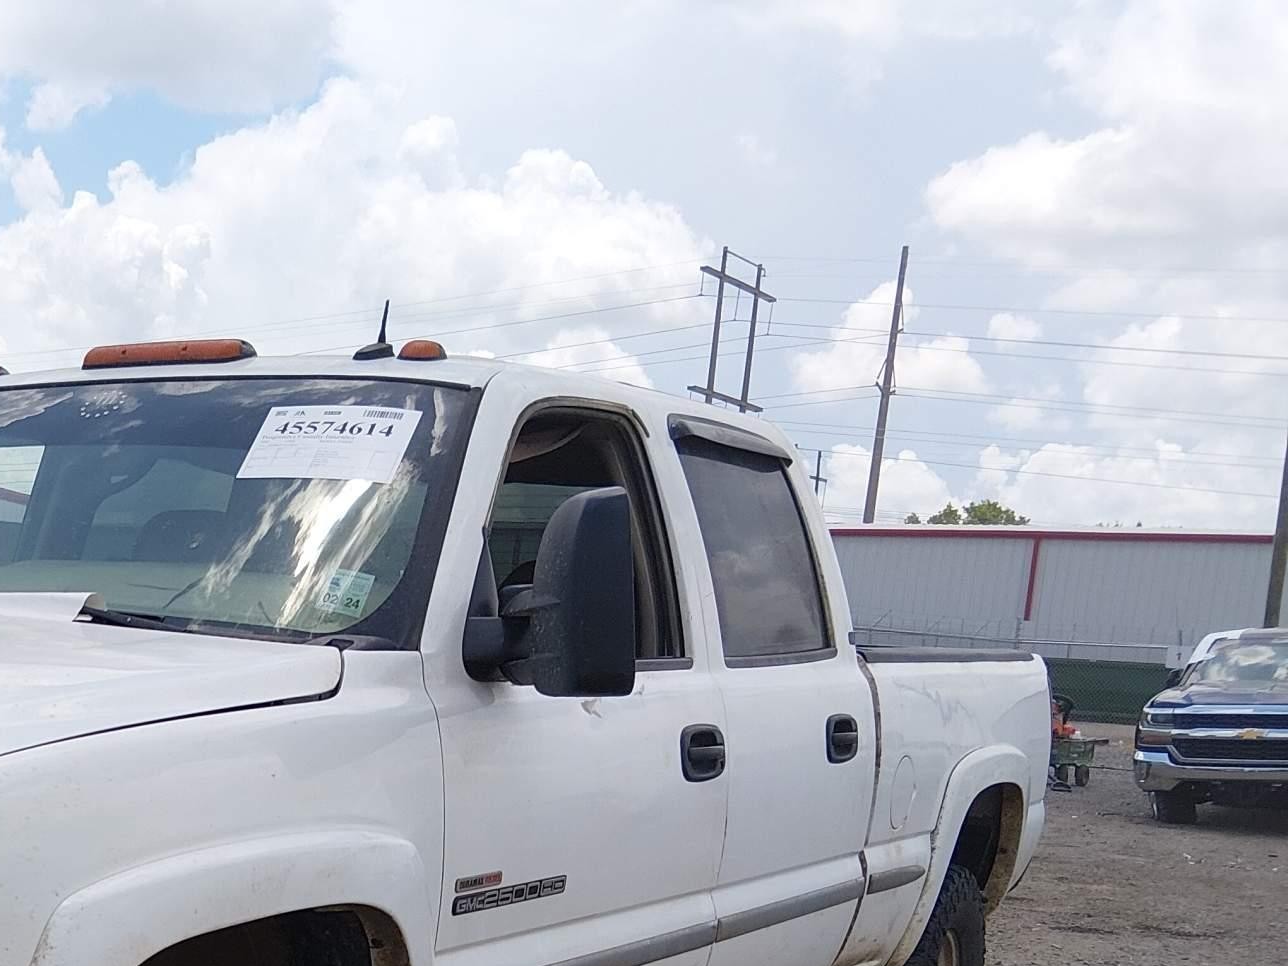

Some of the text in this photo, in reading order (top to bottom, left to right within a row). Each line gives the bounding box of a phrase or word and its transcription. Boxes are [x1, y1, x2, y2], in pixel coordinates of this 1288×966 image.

[274, 421, 395, 438] 45574614
[322, 592, 361, 610] 02 24
